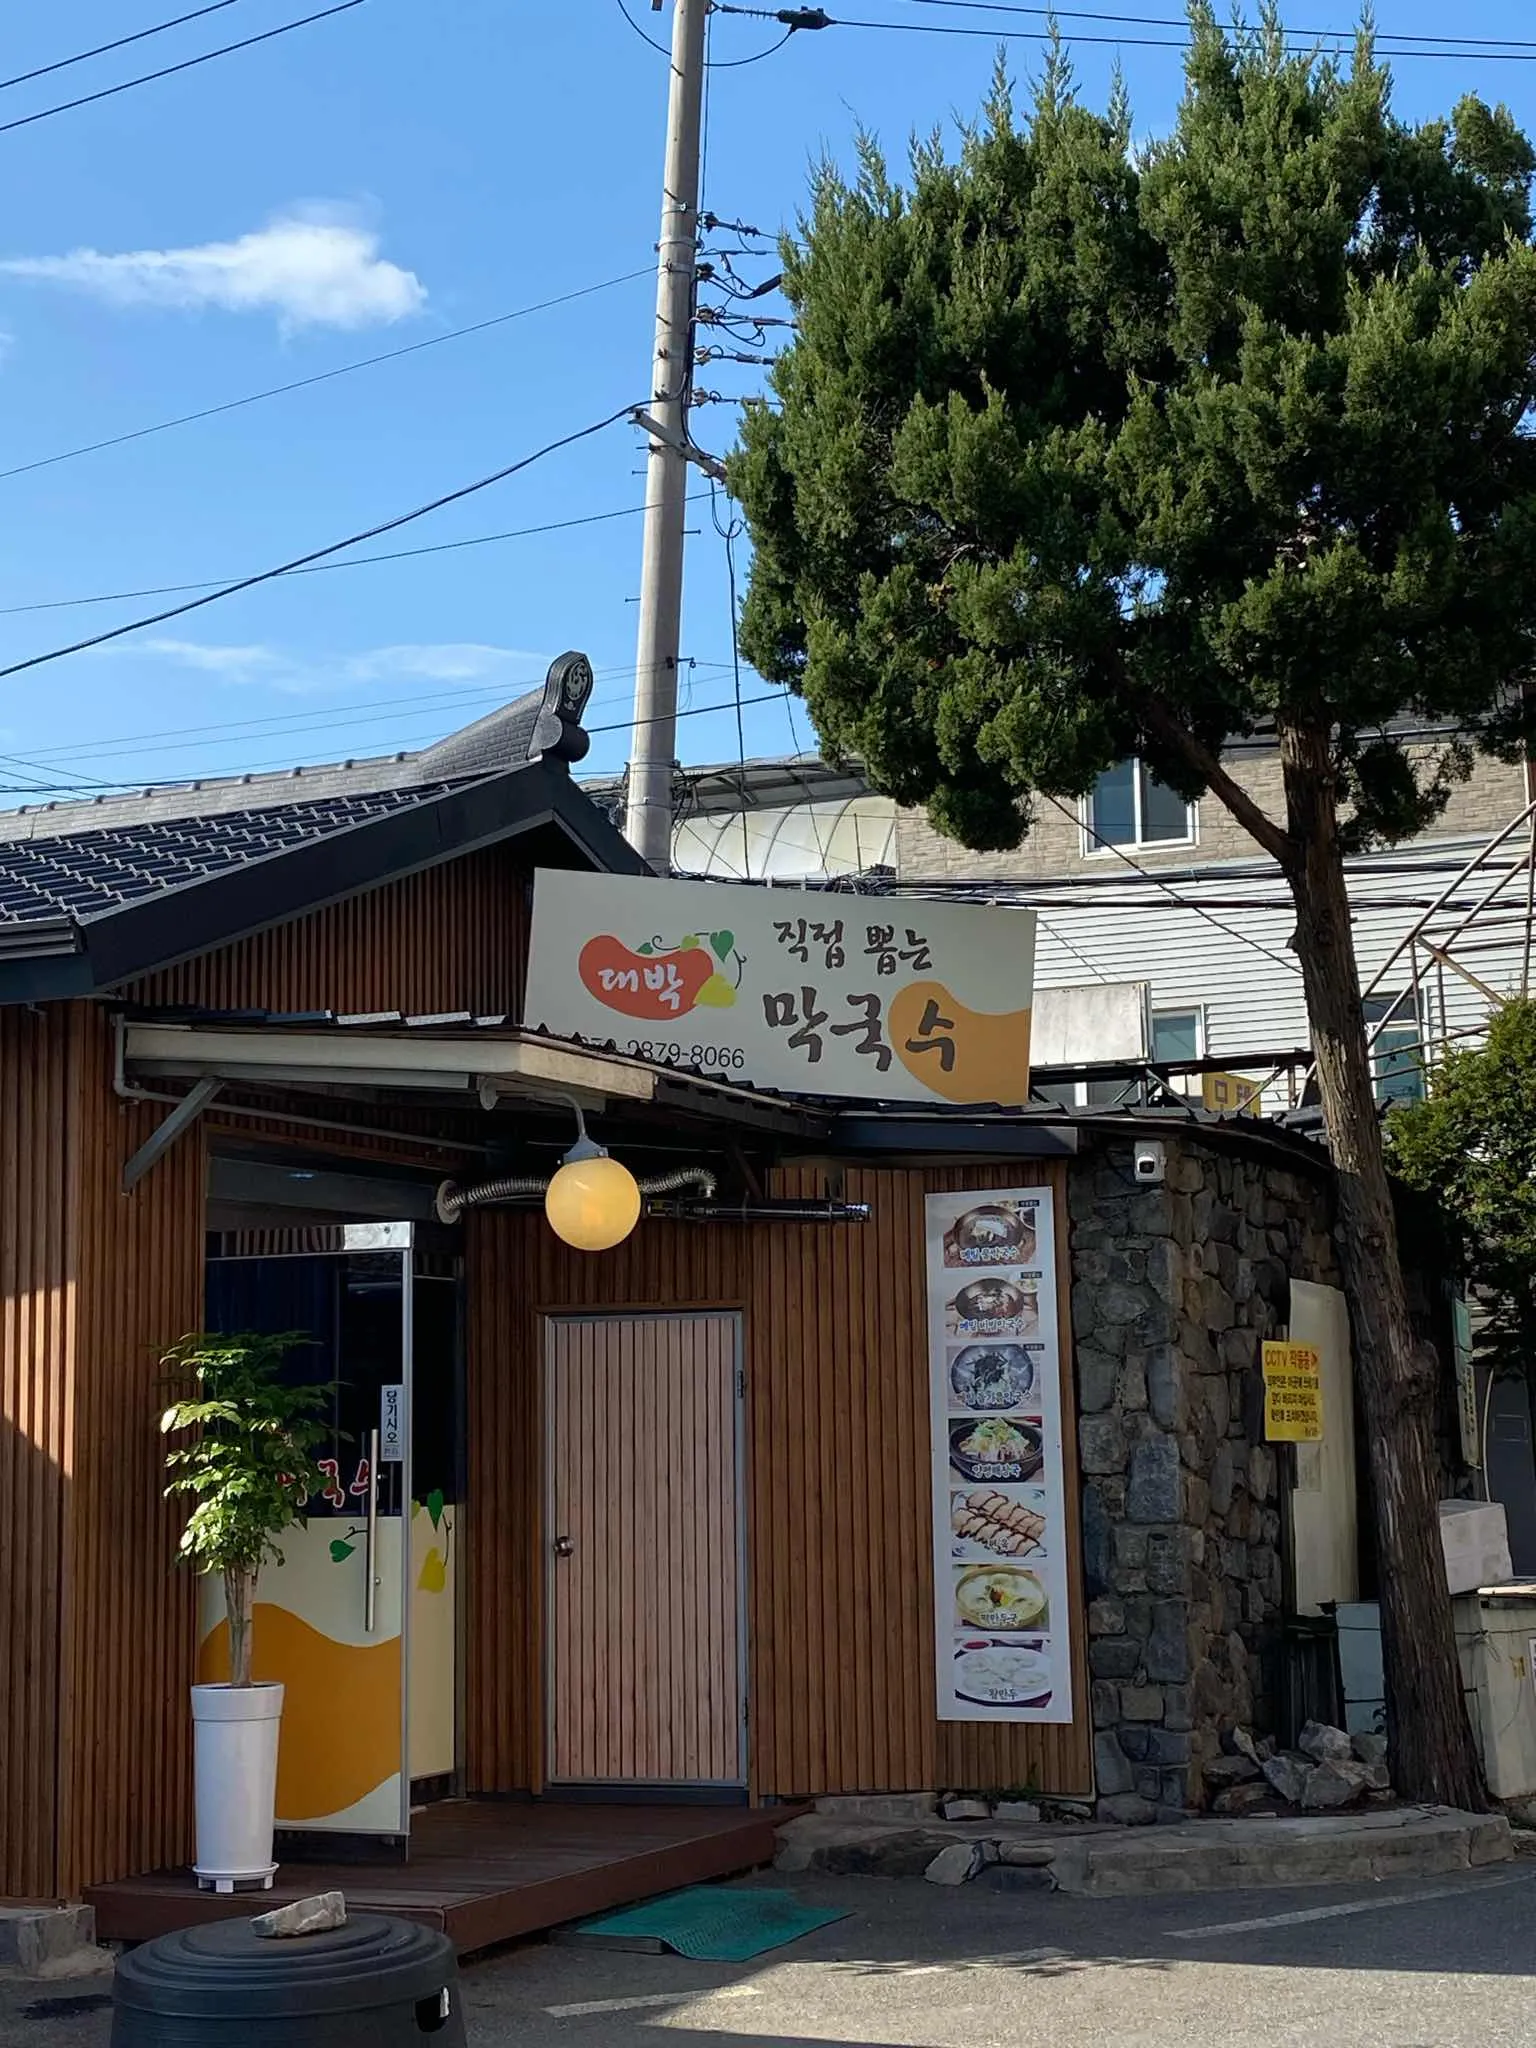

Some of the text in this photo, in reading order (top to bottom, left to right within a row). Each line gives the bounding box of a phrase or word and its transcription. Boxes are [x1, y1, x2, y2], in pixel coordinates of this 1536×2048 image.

[772, 918, 934, 976] 직접 뽑는
[597, 963, 684, 1011] 대박
[762, 986, 956, 1072] 막국수
[1265, 1349, 1287, 1367] CCTV
[386, 1390, 398, 1443] 당기시오
